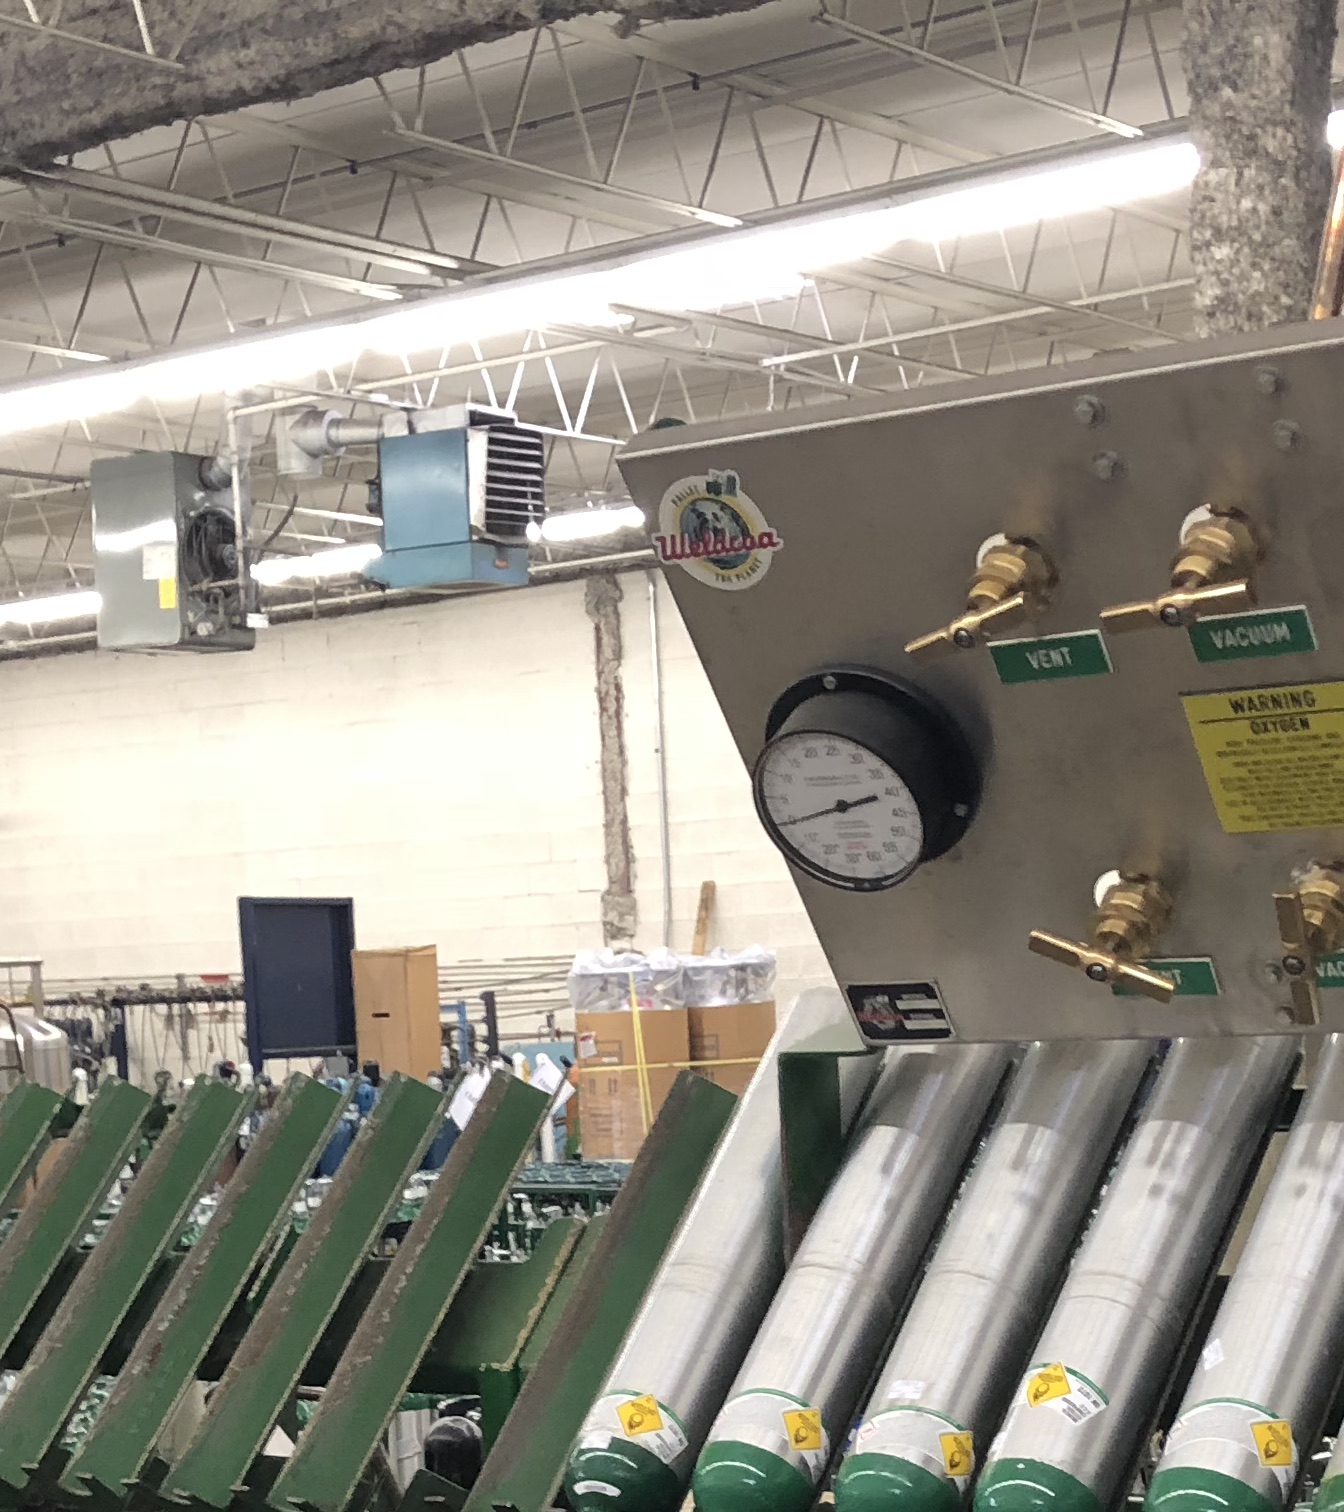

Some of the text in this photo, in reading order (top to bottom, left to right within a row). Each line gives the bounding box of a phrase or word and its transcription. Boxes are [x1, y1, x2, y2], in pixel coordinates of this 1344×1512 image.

[1208, 621, 1292, 650] VACUUM
[1024, 646, 1073, 671] VENT
[1228, 689, 1317, 715] WARNING
[1249, 716, 1310, 735] OXYGEN
